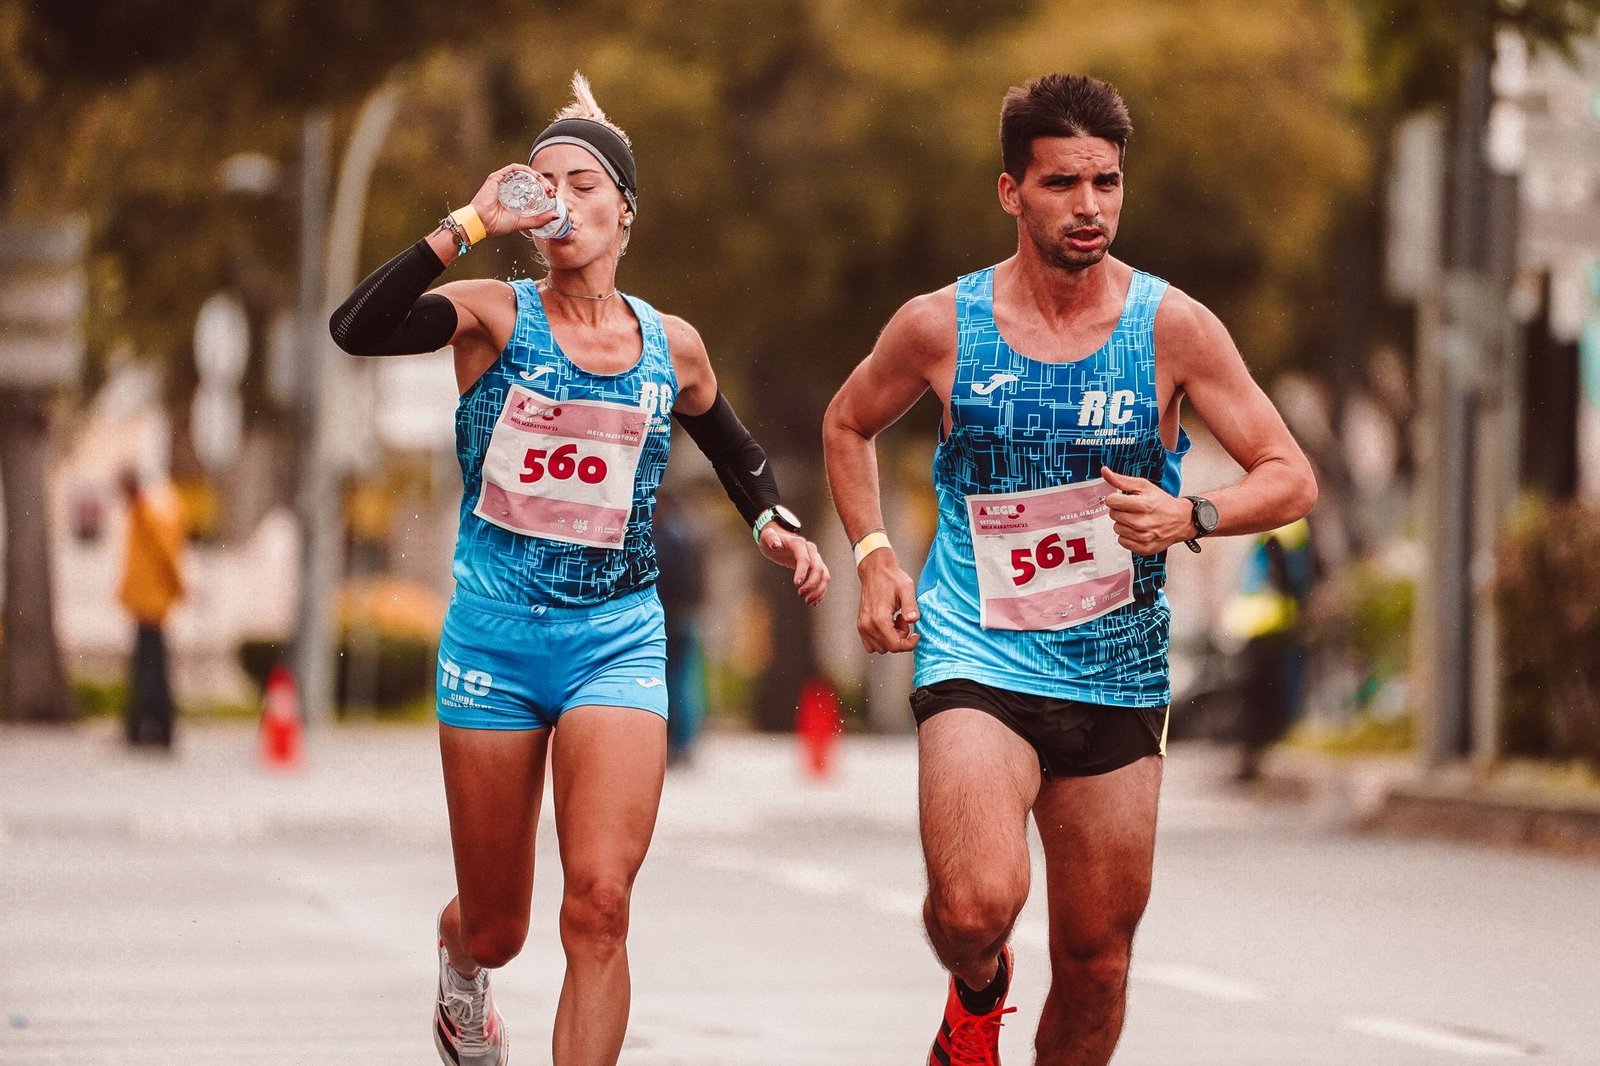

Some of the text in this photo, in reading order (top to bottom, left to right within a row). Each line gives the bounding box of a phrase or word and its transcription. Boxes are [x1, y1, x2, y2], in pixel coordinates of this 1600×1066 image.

[1077, 389, 1136, 427] RC
[586, 429, 604, 437] MEIA
[1094, 428, 1118, 437] CLUBE
[1075, 438, 1104, 446] RAQUEL
[519, 444, 608, 484] 560
[979, 504, 1026, 517] ALEGRO
[1059, 512, 1079, 521] MEIA
[1010, 533, 1094, 587] 561
